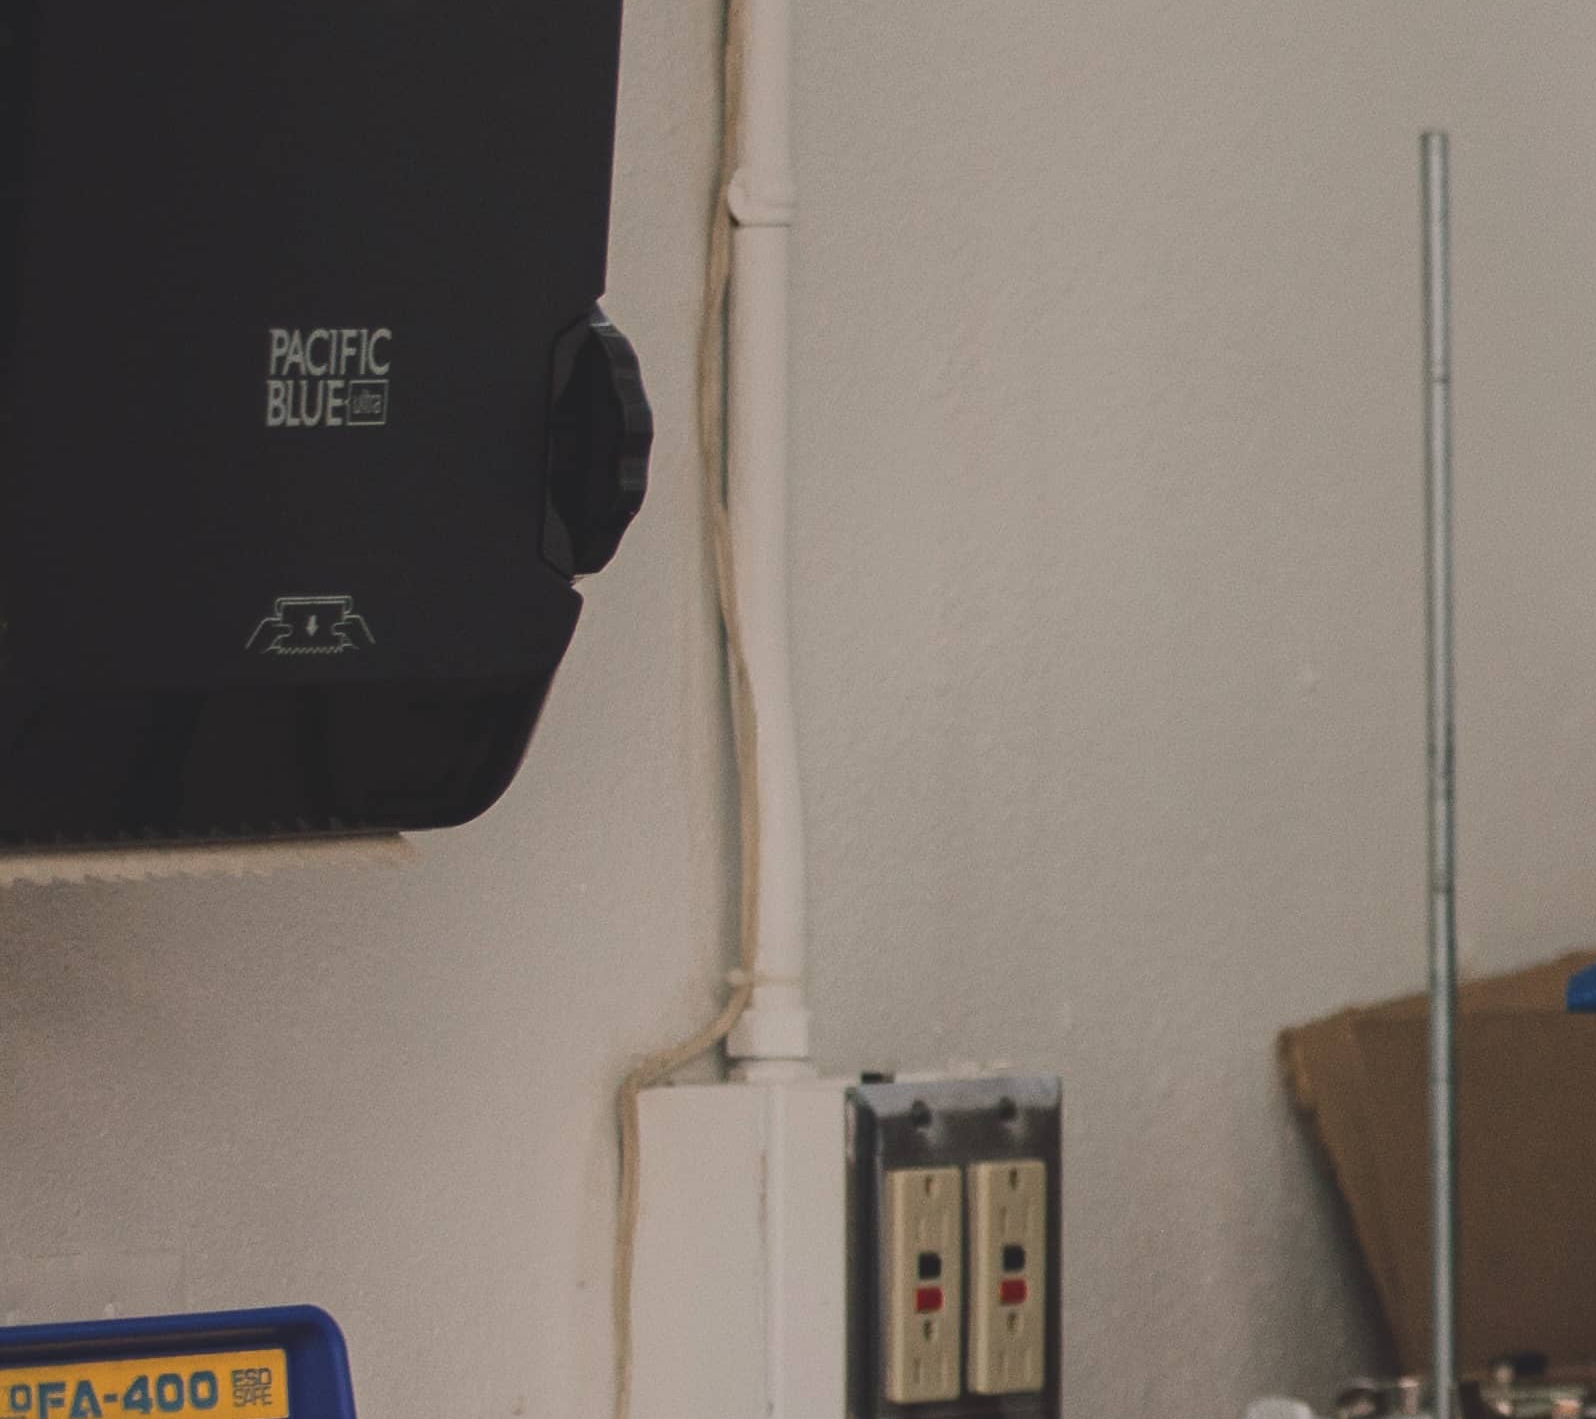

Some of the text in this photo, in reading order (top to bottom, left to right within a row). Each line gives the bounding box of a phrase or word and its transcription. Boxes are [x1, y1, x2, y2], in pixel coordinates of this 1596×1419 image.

[268, 327, 392, 375] PACIFIC
[265, 379, 345, 426] BLUE
[231, 1367, 272, 1388] ESD
[232, 1385, 273, 1408] SAFE
